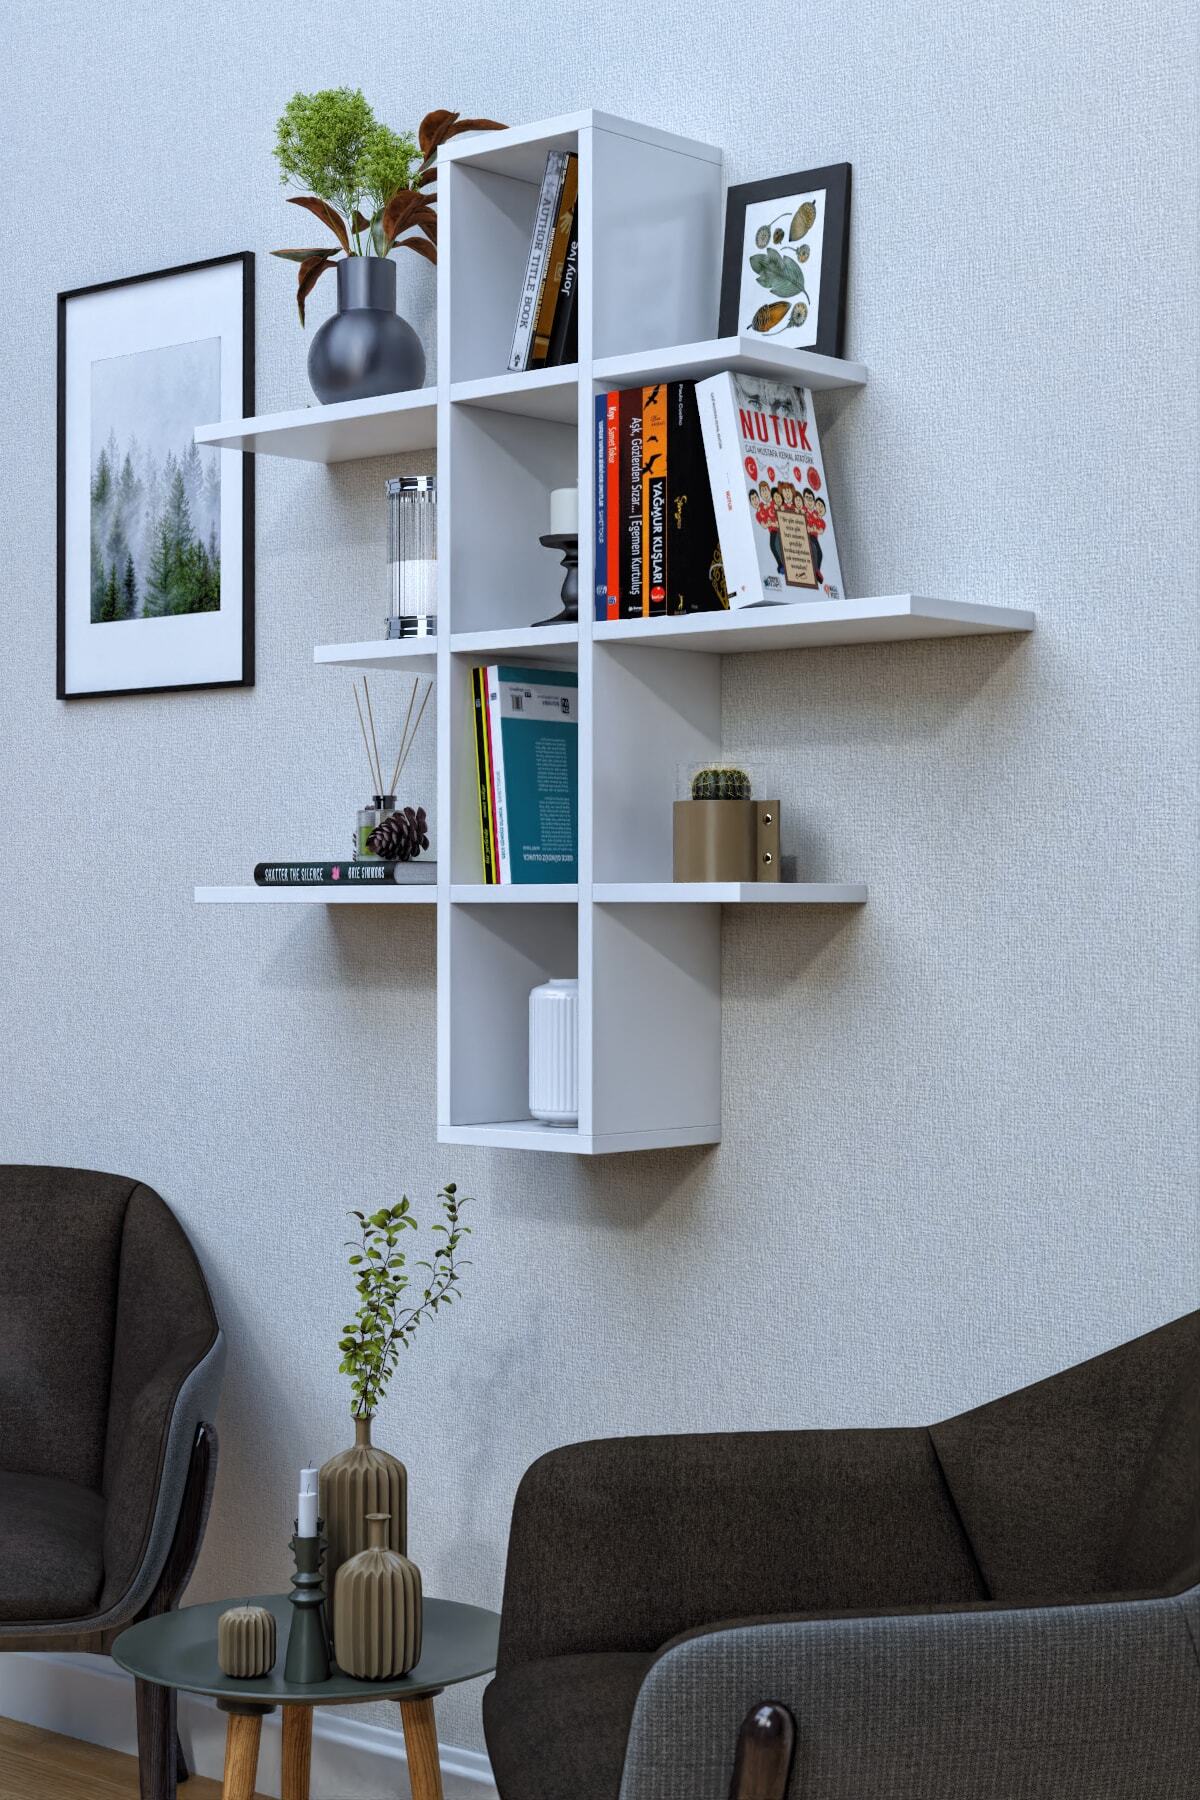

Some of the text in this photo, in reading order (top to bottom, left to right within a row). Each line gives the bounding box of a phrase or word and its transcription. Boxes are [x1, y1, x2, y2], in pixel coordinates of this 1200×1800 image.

[519, 198, 550, 329] AUTHOR TITLE BOOK
[561, 241, 578, 297] Jony Ive
[608, 426, 617, 445] Samet
[629, 417, 642, 437] Aşk,
[739, 408, 812, 452] NUTUK
[631, 438, 643, 483] Gözlerden
[631, 484, 642, 513] Sızar...
[652, 482, 665, 534] YAĞMUR
[629, 520, 642, 556] Egemen
[629, 557, 642, 595] Kurtuluş
[651, 536, 663, 583] KUŞLARI
[265, 868, 323, 880] SHATTER THE SILENCE
[361, 866, 384, 879] SIMMONS
